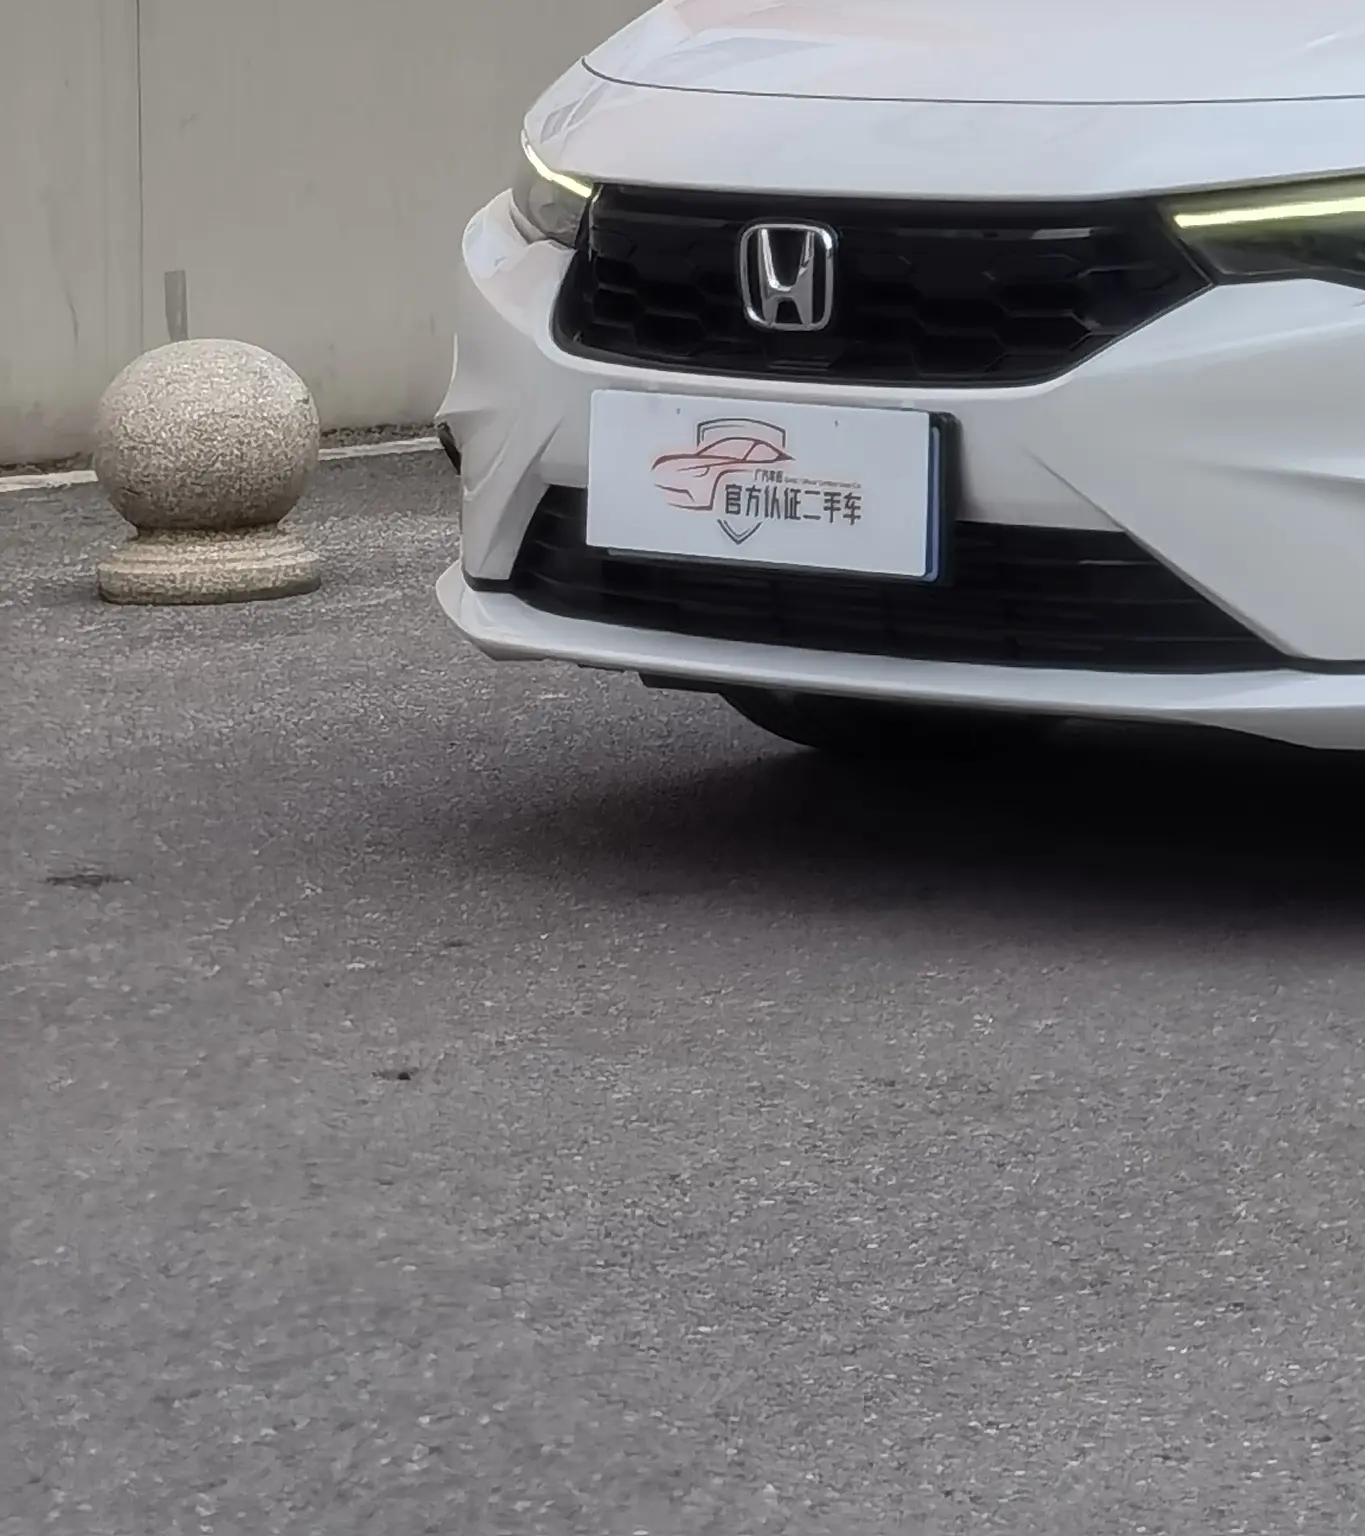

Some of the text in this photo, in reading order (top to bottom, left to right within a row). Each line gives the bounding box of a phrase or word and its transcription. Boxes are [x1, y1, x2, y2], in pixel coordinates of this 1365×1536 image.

[725, 484, 862, 526] 官方认证二手车
